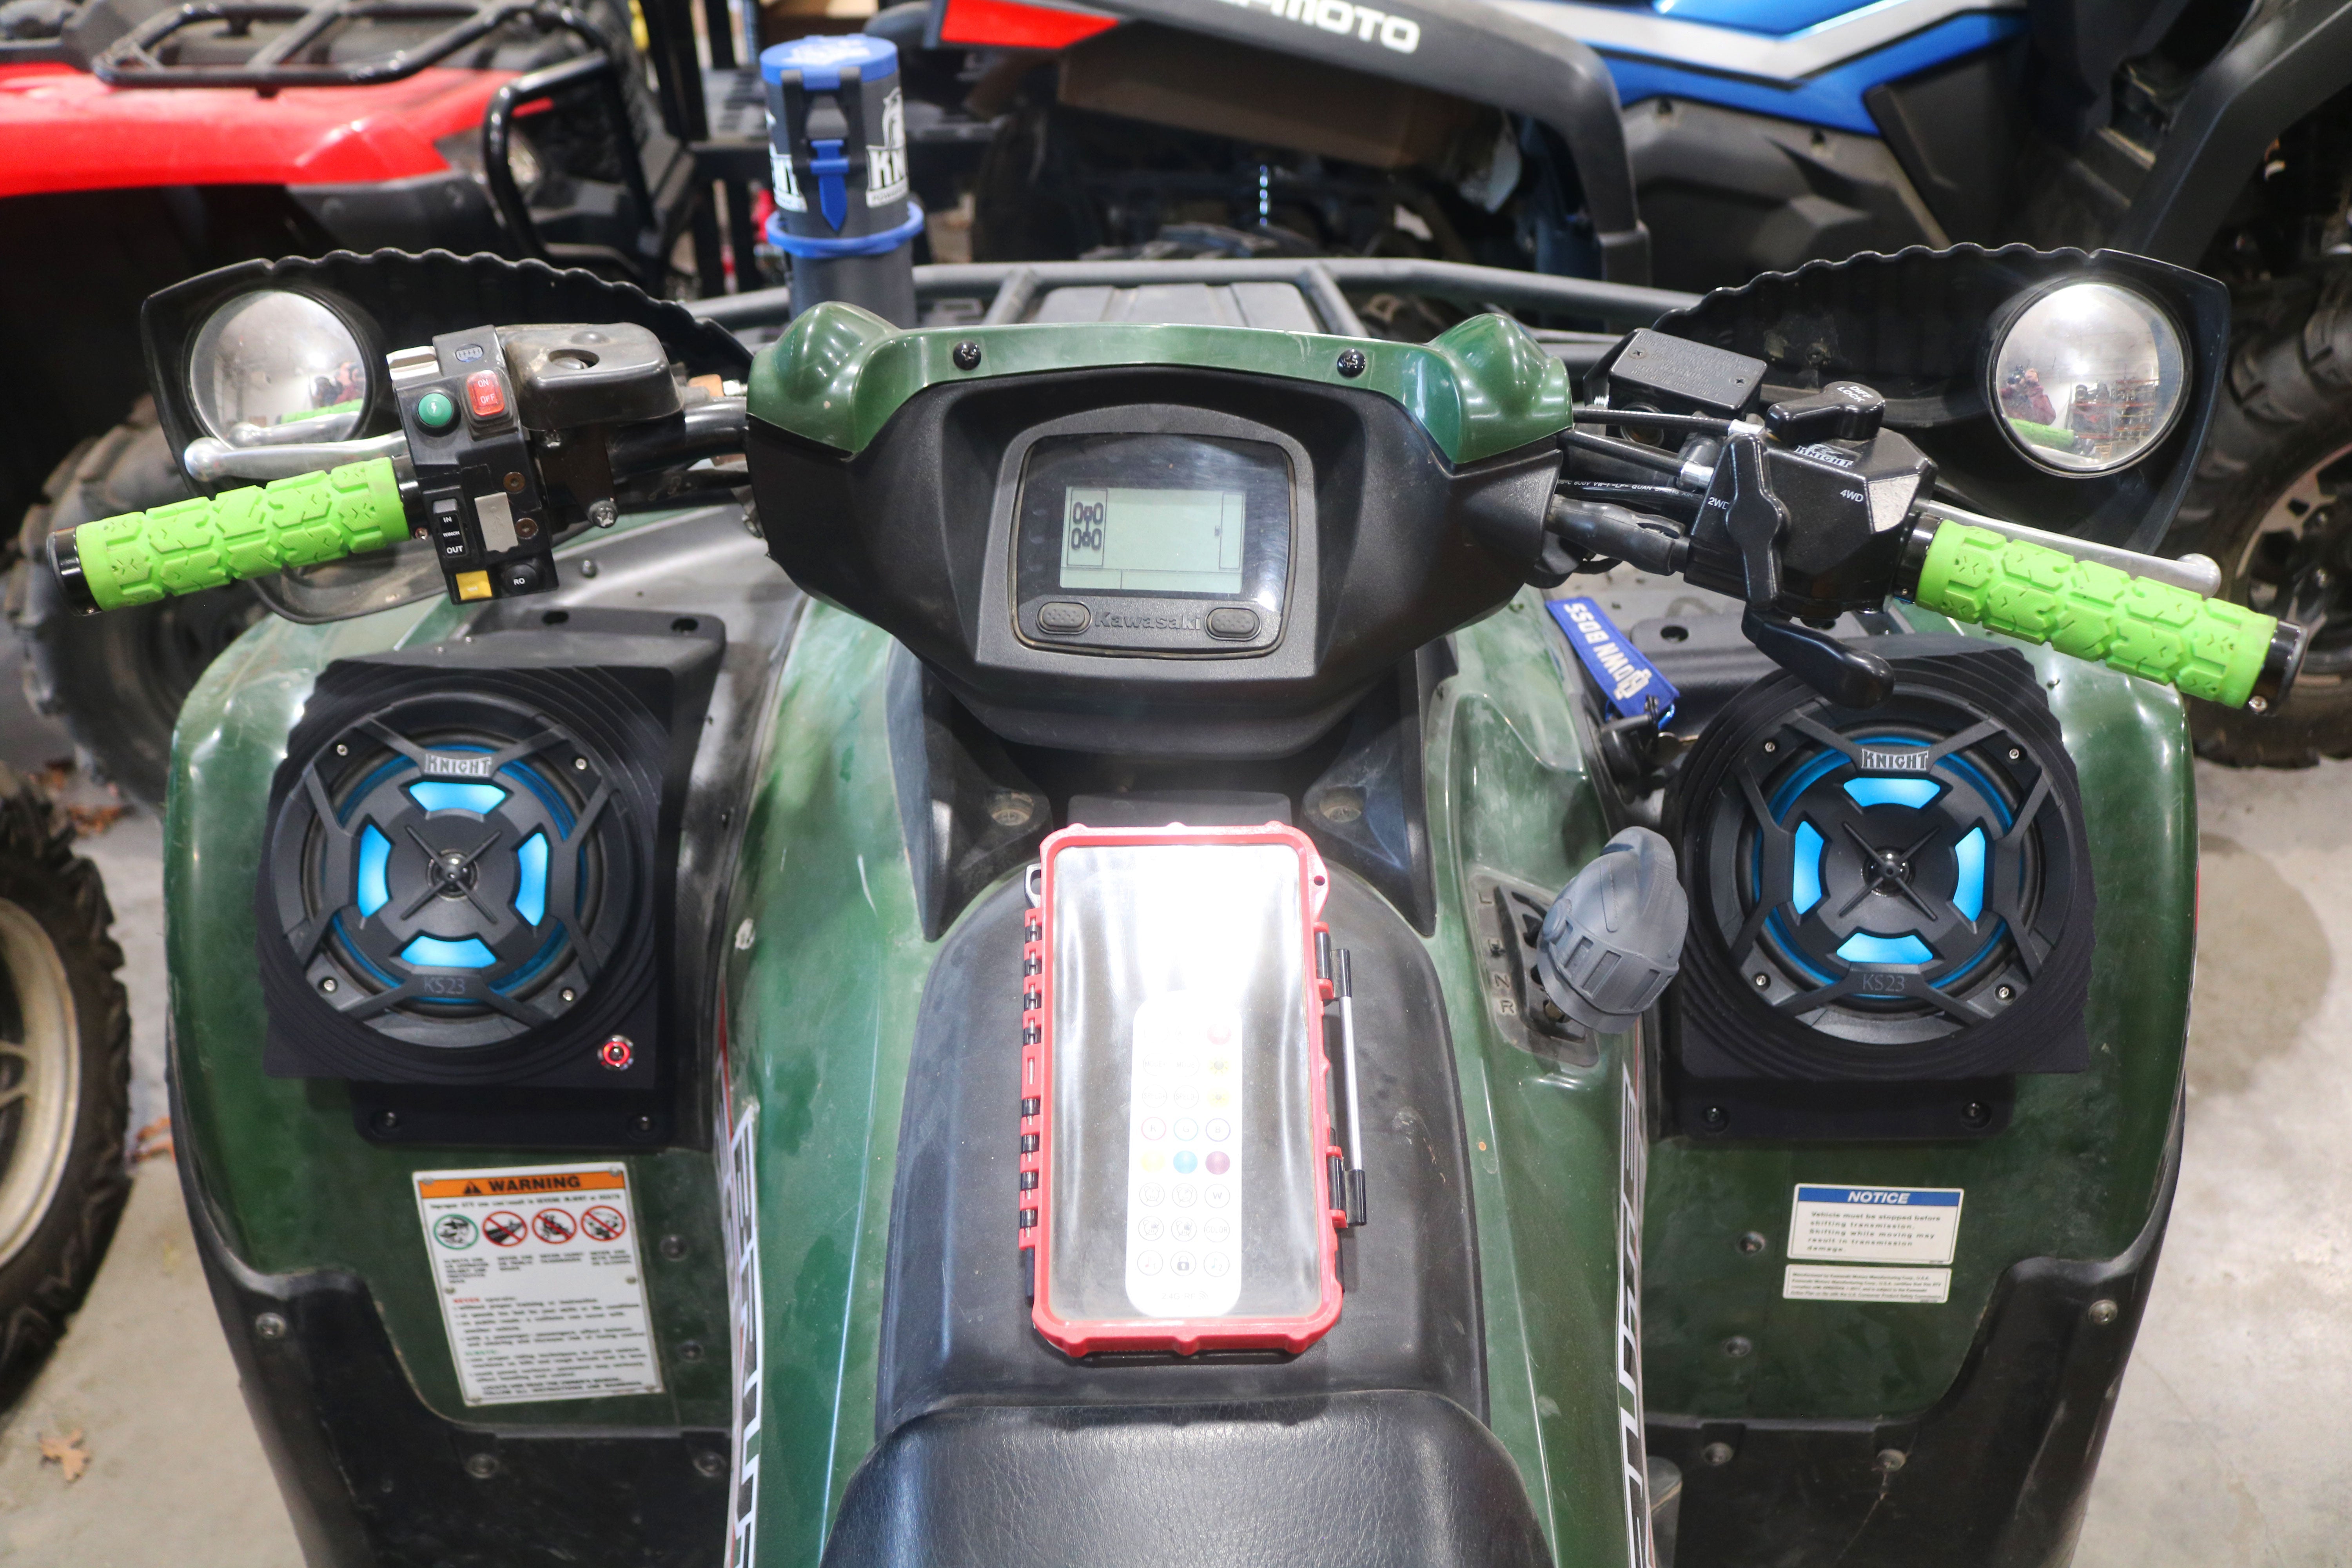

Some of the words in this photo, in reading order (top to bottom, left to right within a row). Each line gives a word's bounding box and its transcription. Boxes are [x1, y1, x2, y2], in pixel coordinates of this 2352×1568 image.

[1217, 0, 1421, 54] MOTO
[477, 379, 489, 388] ON
[480, 393, 495, 404] OFF
[1837, 387, 1865, 402] LOCK
[1849, 386, 1873, 398] DIFF
[1794, 446, 1853, 467] KNIGHT
[1840, 489, 1864, 503] 4WD
[446, 545, 463, 554] OUT
[1094, 611, 1201, 632] Kawasaki
[1563, 603, 1610, 644] BOSS
[425, 754, 492, 777] KNIGHT
[1861, 748, 1930, 771] KNIGHT
[424, 976, 465, 995] KS23
[1494, 974, 1509, 988] N
[1862, 974, 1905, 992] KS23
[1500, 1000, 1514, 1014] R
[488, 1176, 581, 1192] WARNING
[1847, 1191, 1910, 1204] NOTICE
